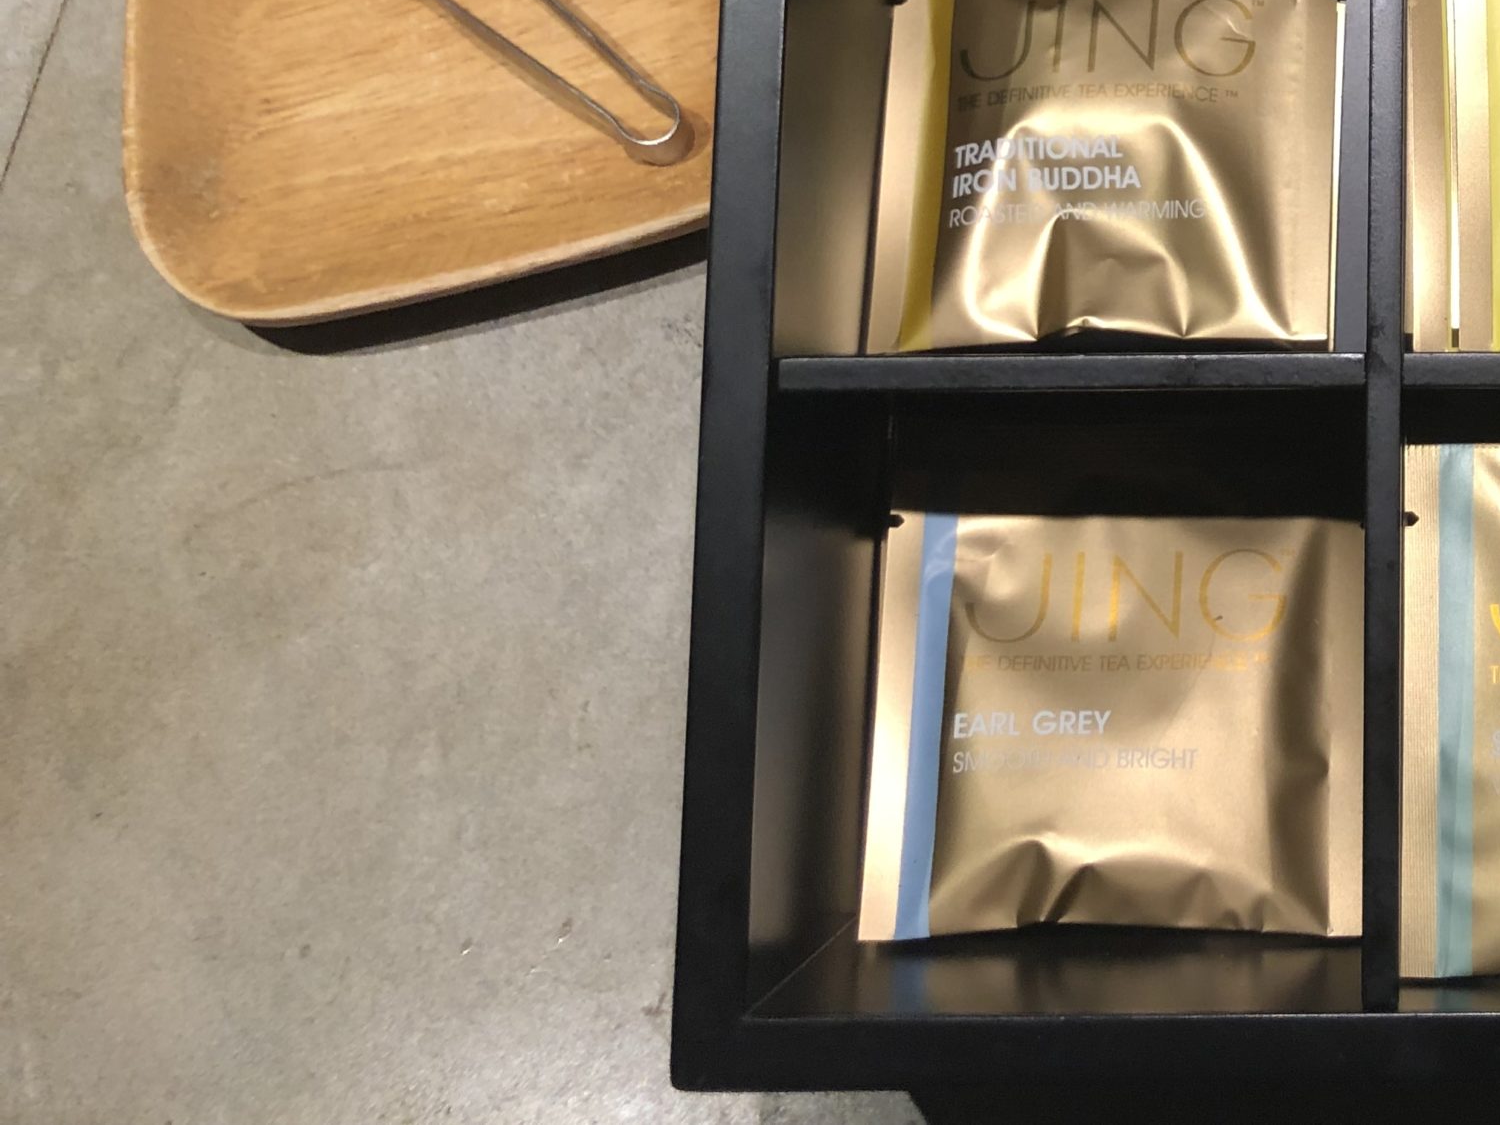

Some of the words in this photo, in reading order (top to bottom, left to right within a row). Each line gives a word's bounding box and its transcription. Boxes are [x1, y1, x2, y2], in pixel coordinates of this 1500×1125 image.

[986, 84, 1072, 107] DEFINITIVE
[1077, 83, 1109, 98] TEA
[1113, 83, 1219, 104] EXPERIENCE
[953, 133, 1124, 170] TRADITIONAL
[951, 167, 1018, 199] IRON
[1027, 164, 1143, 192] BUDDHA
[964, 547, 1289, 645] JING
[999, 654, 1092, 673] DEFINITIVE
[1099, 654, 1132, 673] TEA
[1136, 651, 1250, 673] EXPERIE
[951, 710, 1022, 740] EARL
[1031, 708, 1112, 737] GREY
[1115, 745, 1199, 771] BRIGHT
